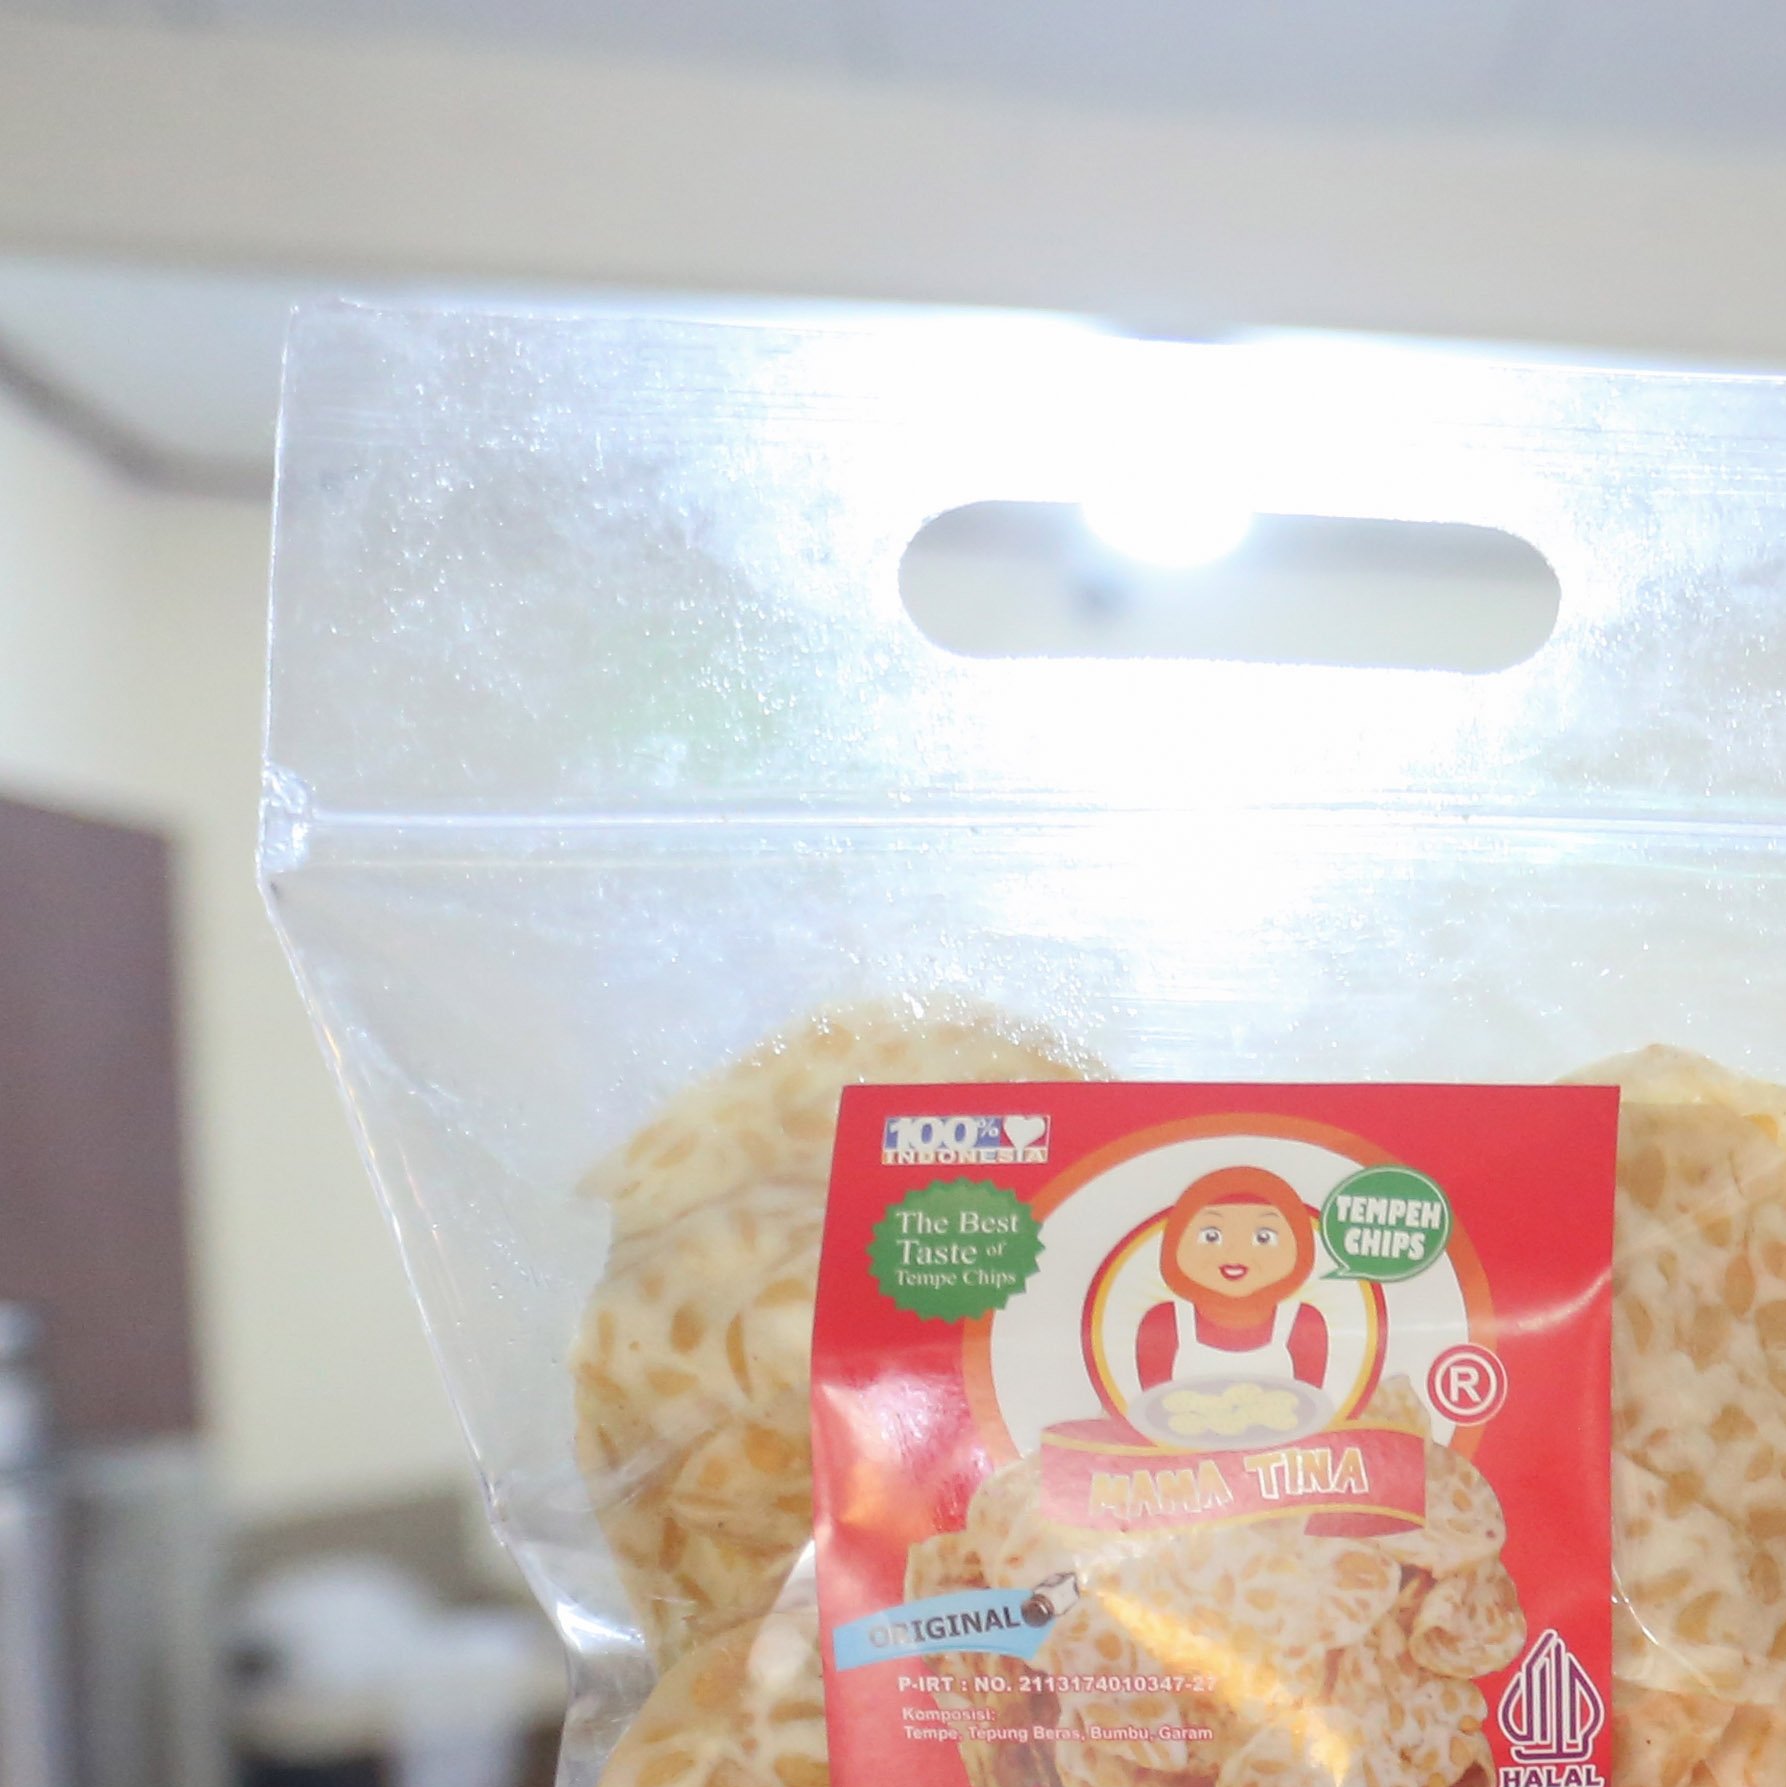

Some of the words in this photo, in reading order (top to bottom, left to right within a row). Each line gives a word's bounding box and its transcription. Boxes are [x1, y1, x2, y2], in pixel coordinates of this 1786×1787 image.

[889, 1116, 999, 1149] 100%
[882, 1149, 1048, 1165] INDONESIA
[896, 1211, 948, 1234] The
[960, 1211, 1019, 1234] Best
[1336, 1194, 1442, 1230] TEMPEH
[896, 1240, 977, 1265] Taste
[987, 1241, 1006, 1257] of
[1344, 1231, 1426, 1261] CHIPS
[895, 1270, 957, 1289] Tempe
[963, 1269, 1017, 1288] Chips
[1088, 1459, 1234, 1519] MAMA
[1244, 1447, 1370, 1500] TINA
[869, 1606, 1021, 1648] ORIGINAL
[898, 1677, 954, 1692] P-IRT
[974, 1677, 1011, 1692] NO.
[902, 1708, 997, 1725] Komposisi:
[969, 1726, 1028, 1743] Tepung
[1033, 1726, 1085, 1742] Beras,
[1091, 1726, 1153, 1742] Bumbu,
[1158, 1726, 1213, 1740] Garam
